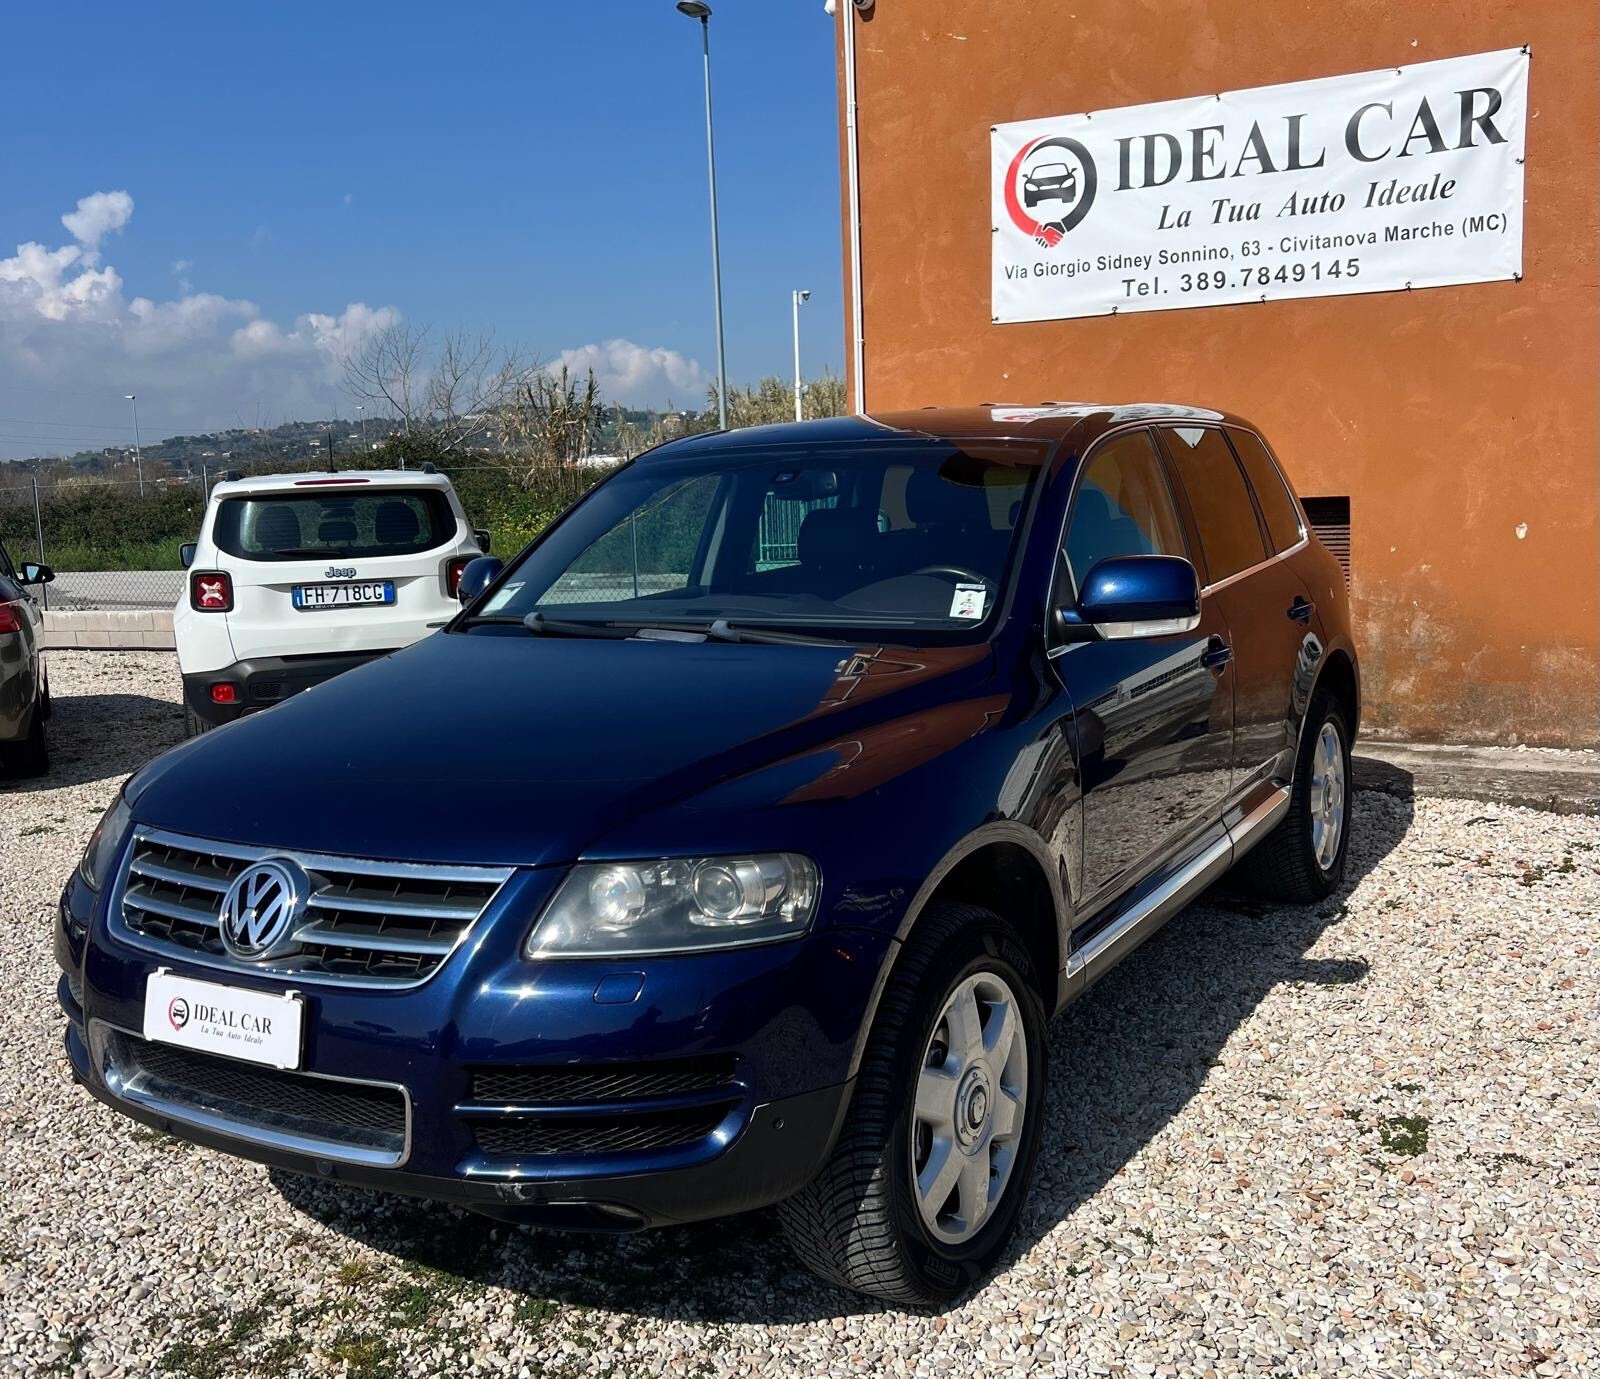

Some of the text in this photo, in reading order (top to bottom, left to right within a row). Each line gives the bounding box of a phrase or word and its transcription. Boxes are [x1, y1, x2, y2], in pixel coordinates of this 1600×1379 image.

[1113, 87, 1509, 192] IDEAL CAR
[1157, 172, 1457, 231] La Tua Auto Ideale
[1004, 265, 1028, 280] Via
[1033, 258, 1091, 278] Giorgio
[1096, 254, 1152, 271] Sidney
[1158, 245, 1234, 265] Sonnino,
[1241, 240, 1261, 257] 63
[1279, 232, 1377, 253] Civitanova
[1384, 221, 1454, 243] Marche
[1462, 212, 1508, 238] (MC)
[1121, 257, 1360, 297] Tel. 389.7849145
[325, 567, 356, 578] Jeep
[194, 1003, 272, 1035] IDEAL CAR
[200, 1025, 263, 1045] La Tua Auto Ideale
